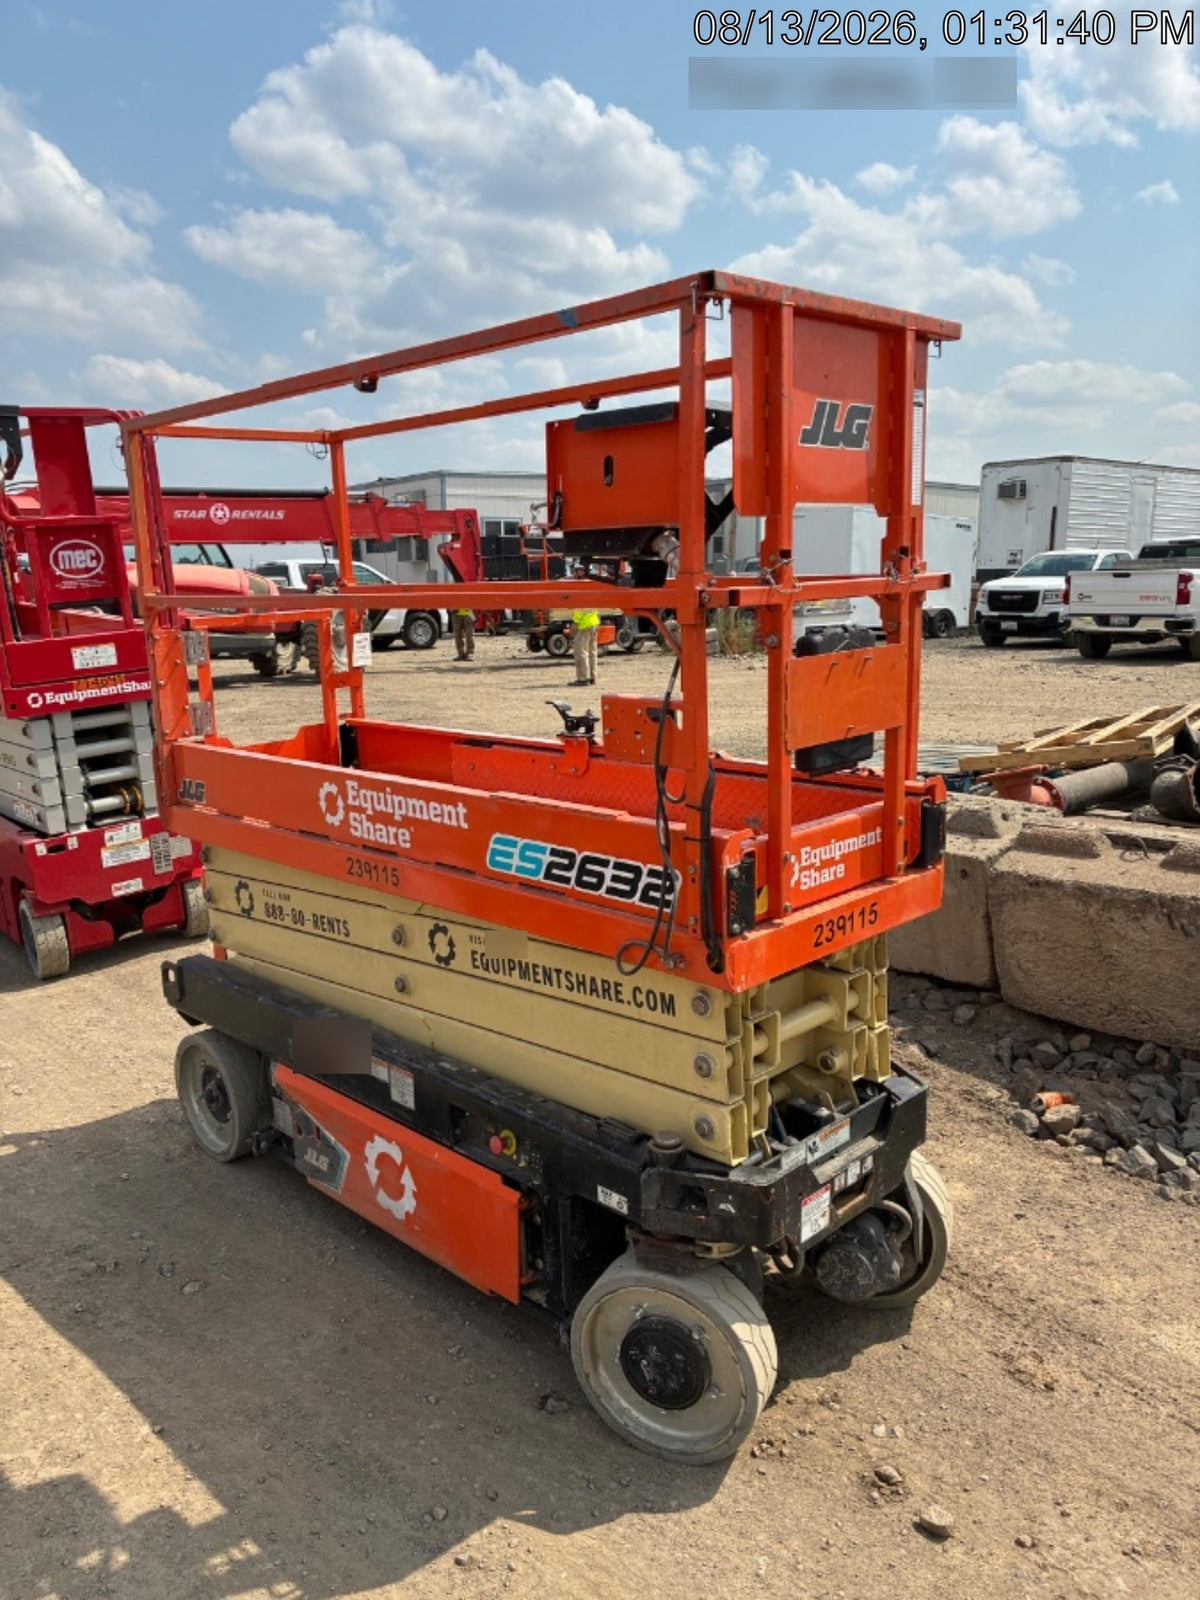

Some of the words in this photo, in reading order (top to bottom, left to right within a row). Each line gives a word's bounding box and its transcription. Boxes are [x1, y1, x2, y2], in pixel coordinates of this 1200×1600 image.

[798, 398, 874, 451] JLG
[173, 510, 206, 519] STAR
[231, 510, 285, 520] RENTALS
[44, 680, 152, 705] EquipmentSha
[178, 778, 206, 804] JLG
[345, 780, 469, 829] Equipment
[349, 812, 412, 849] Share
[799, 826, 882, 866] Equipment
[346, 857, 400, 887] 239115
[486, 832, 682, 913] ES2632
[799, 861, 845, 891] Share
[264, 902, 351, 938] 888-80-RENTS
[813, 902, 879, 948] 239115
[470, 949, 677, 1018] EQUIPMENTSHARE.COM
[303, 1147, 330, 1172] JLG
